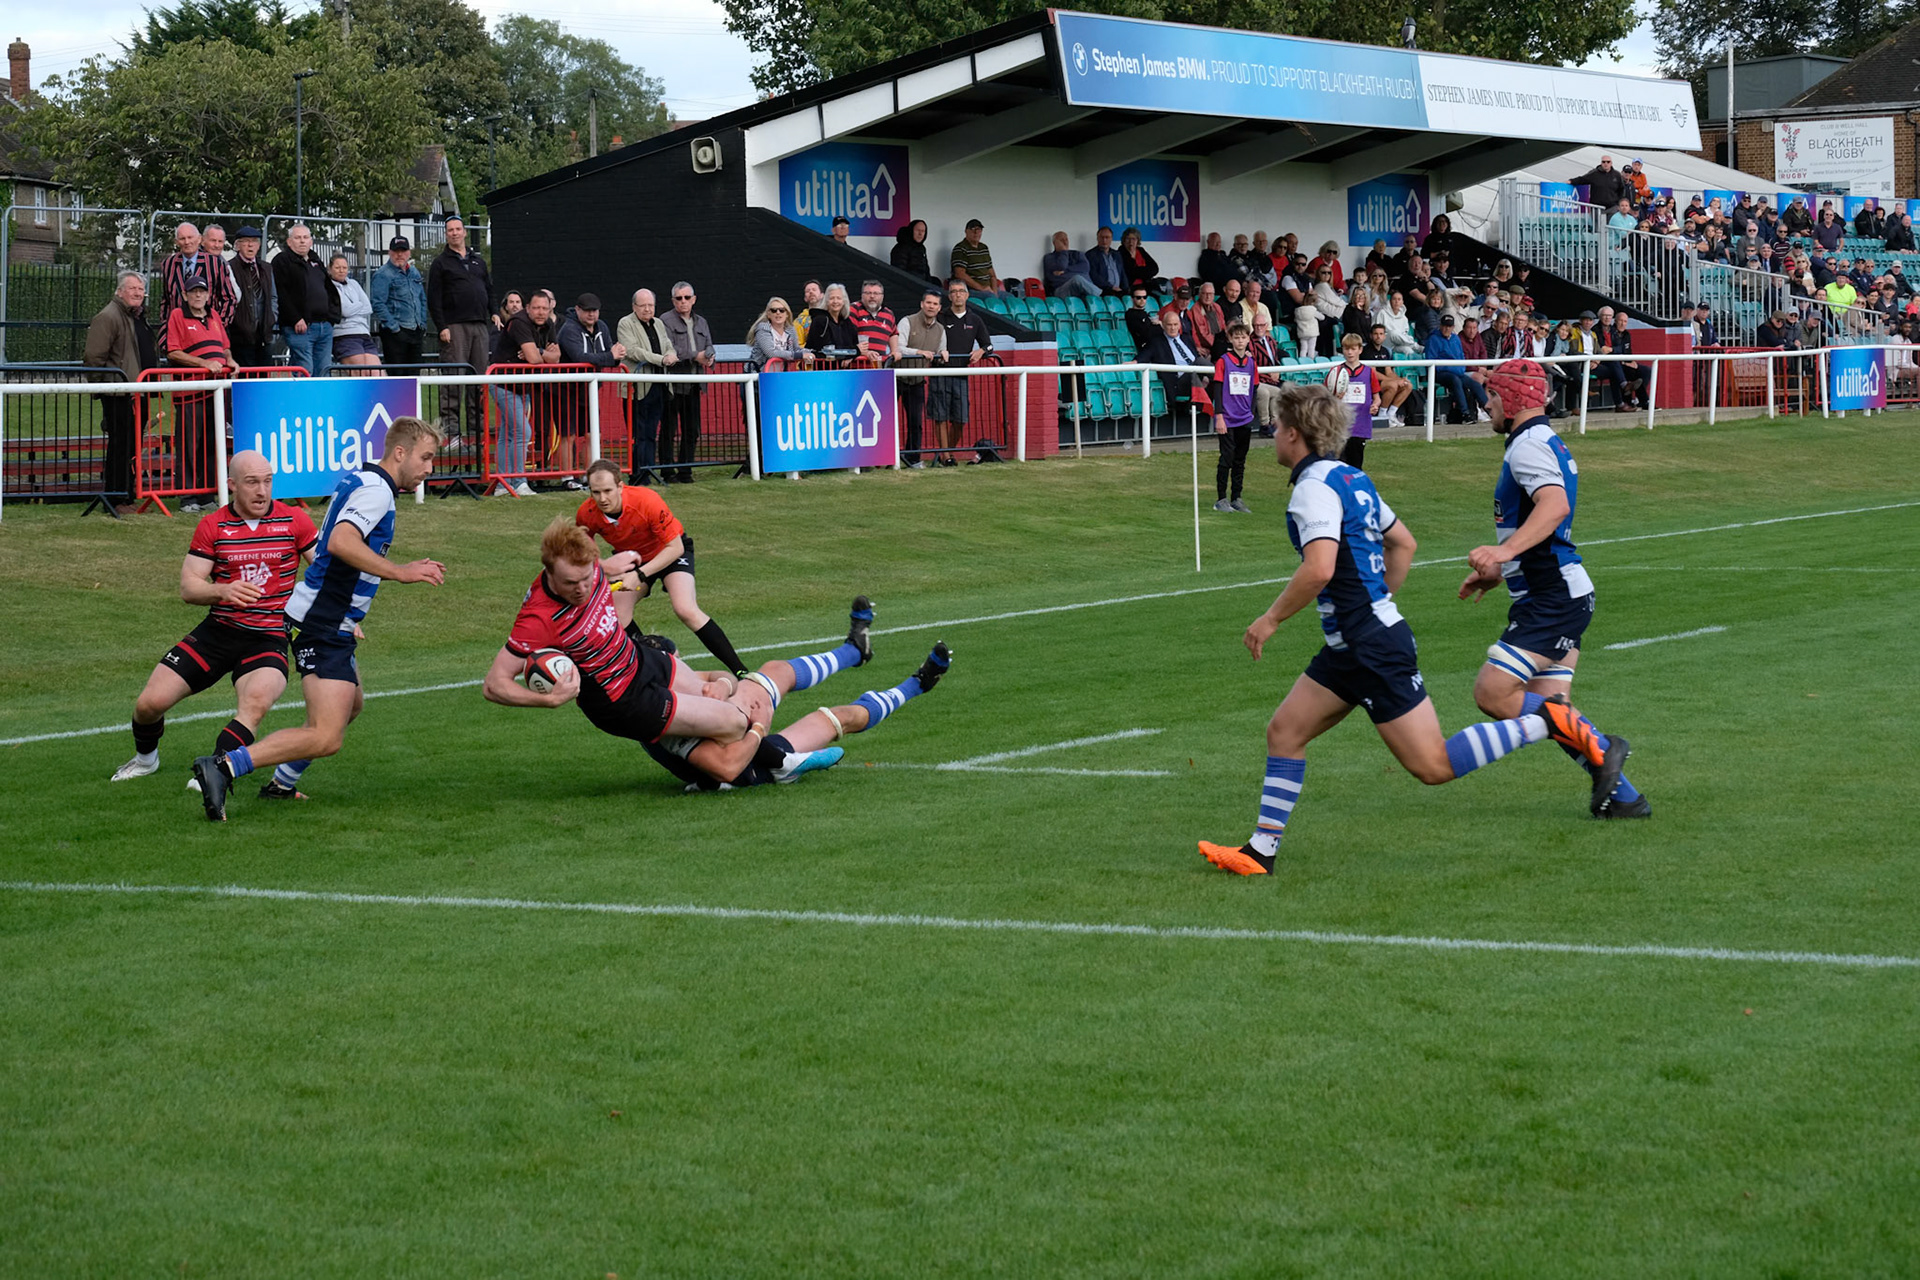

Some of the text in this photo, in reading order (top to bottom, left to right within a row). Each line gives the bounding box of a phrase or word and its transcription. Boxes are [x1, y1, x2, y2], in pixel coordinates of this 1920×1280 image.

[1092, 48, 1140, 77] Stephen
[1142, 53, 1177, 78] James
[1211, 60, 1251, 84] PROUD
[1251, 64, 1268, 87] TO
[1268, 65, 1317, 91] SUPPORT
[1320, 71, 1385, 97] BLACKHEATH
[1427, 84, 1466, 104] STEPHEN
[1467, 87, 1494, 107] JAMES
[1515, 93, 1542, 111] PROUD
[1542, 96, 1554, 112] TO
[1556, 97, 1590, 116] SUPPORT
[1590, 100, 1639, 120] BLACKHEATH
[1809, 136, 1883, 150] BLACKHEATH
[1827, 148, 1865, 159] RUGBY
[795, 169, 871, 219] utilita
[1109, 184, 1171, 227] utilita
[1357, 194, 1406, 234] utilita
[1836, 367, 1870, 398] utilita
[255, 416, 363, 475] utilita
[776, 401, 855, 452] utilita
[227, 552, 282, 561] GREENE KING
